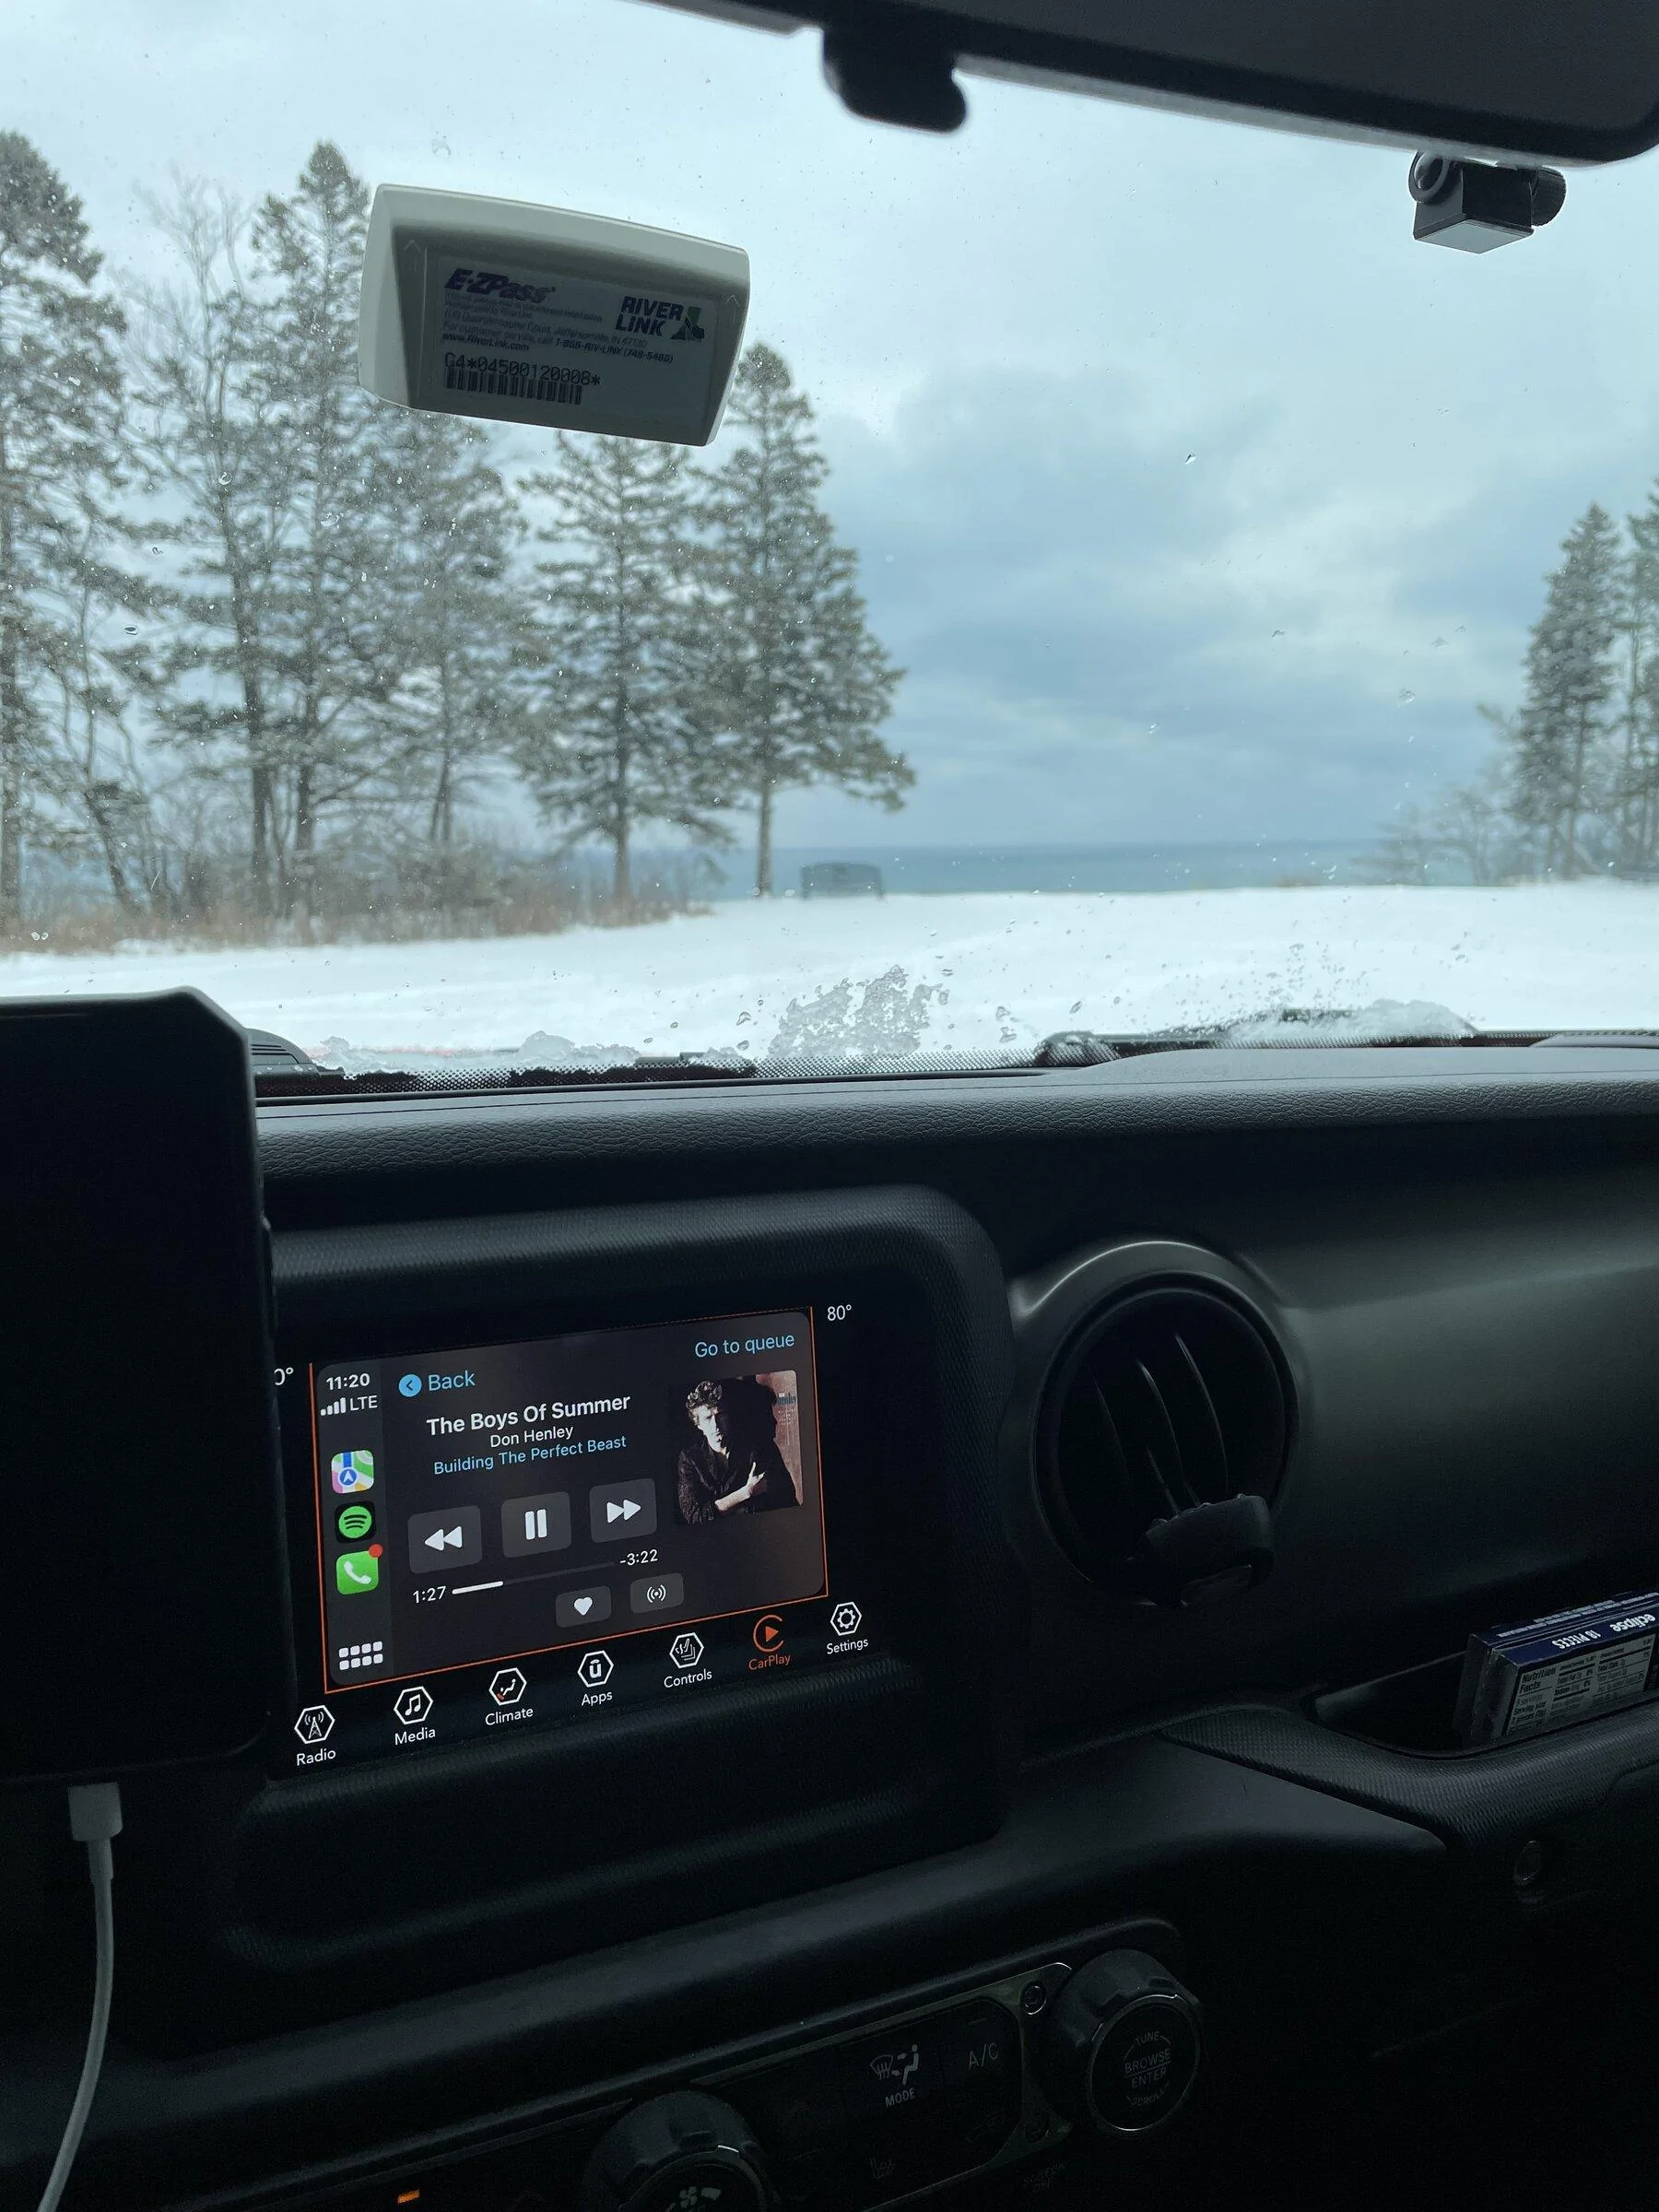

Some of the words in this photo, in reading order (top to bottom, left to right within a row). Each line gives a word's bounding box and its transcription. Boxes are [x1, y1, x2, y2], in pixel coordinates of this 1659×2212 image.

[620, 296, 684, 321] RIVER
[616, 313, 665, 336] LINK
[828, 1304, 852, 1322] 80°
[695, 1341, 719, 1358] Go
[723, 1340, 739, 1354] to
[745, 1335, 794, 1356] queue
[325, 1372, 371, 1391] 11:20
[428, 1371, 476, 1392] Back
[349, 1394, 378, 1411] LTE
[426, 1417, 465, 1435] The
[470, 1410, 519, 1431] Boys
[523, 1403, 547, 1423] Of
[551, 1394, 631, 1419] Summer
[489, 1434, 519, 1448] Don
[524, 1426, 574, 1444] Henley
[434, 1455, 494, 1475] Building
[499, 1451, 526, 1465] The
[531, 1441, 583, 1461] Perfect
[587, 1435, 627, 1453] Beast
[619, 1549, 658, 1566] -3:22
[412, 1585, 447, 1604] 1:27
[1609, 1613, 1656, 1632] eclipse
[826, 1635, 869, 1654] Settings
[1552, 1633, 1591, 1649] PIECES
[748, 1652, 791, 1670] CarPlay
[664, 1668, 712, 1688] Controls
[1522, 1667, 1557, 1683] Nutrition
[581, 1688, 613, 1707] Apps
[1520, 1681, 1541, 1694] Facts
[485, 1704, 534, 1726] Climate
[394, 1726, 436, 1746] Media
[296, 1747, 336, 1767] Radio
[968, 2041, 999, 2070] A/C
[1124, 2048, 1171, 2074] BROWSE
[1131, 2065, 1168, 2088] ENTER
[885, 2087, 916, 2108] MODE
